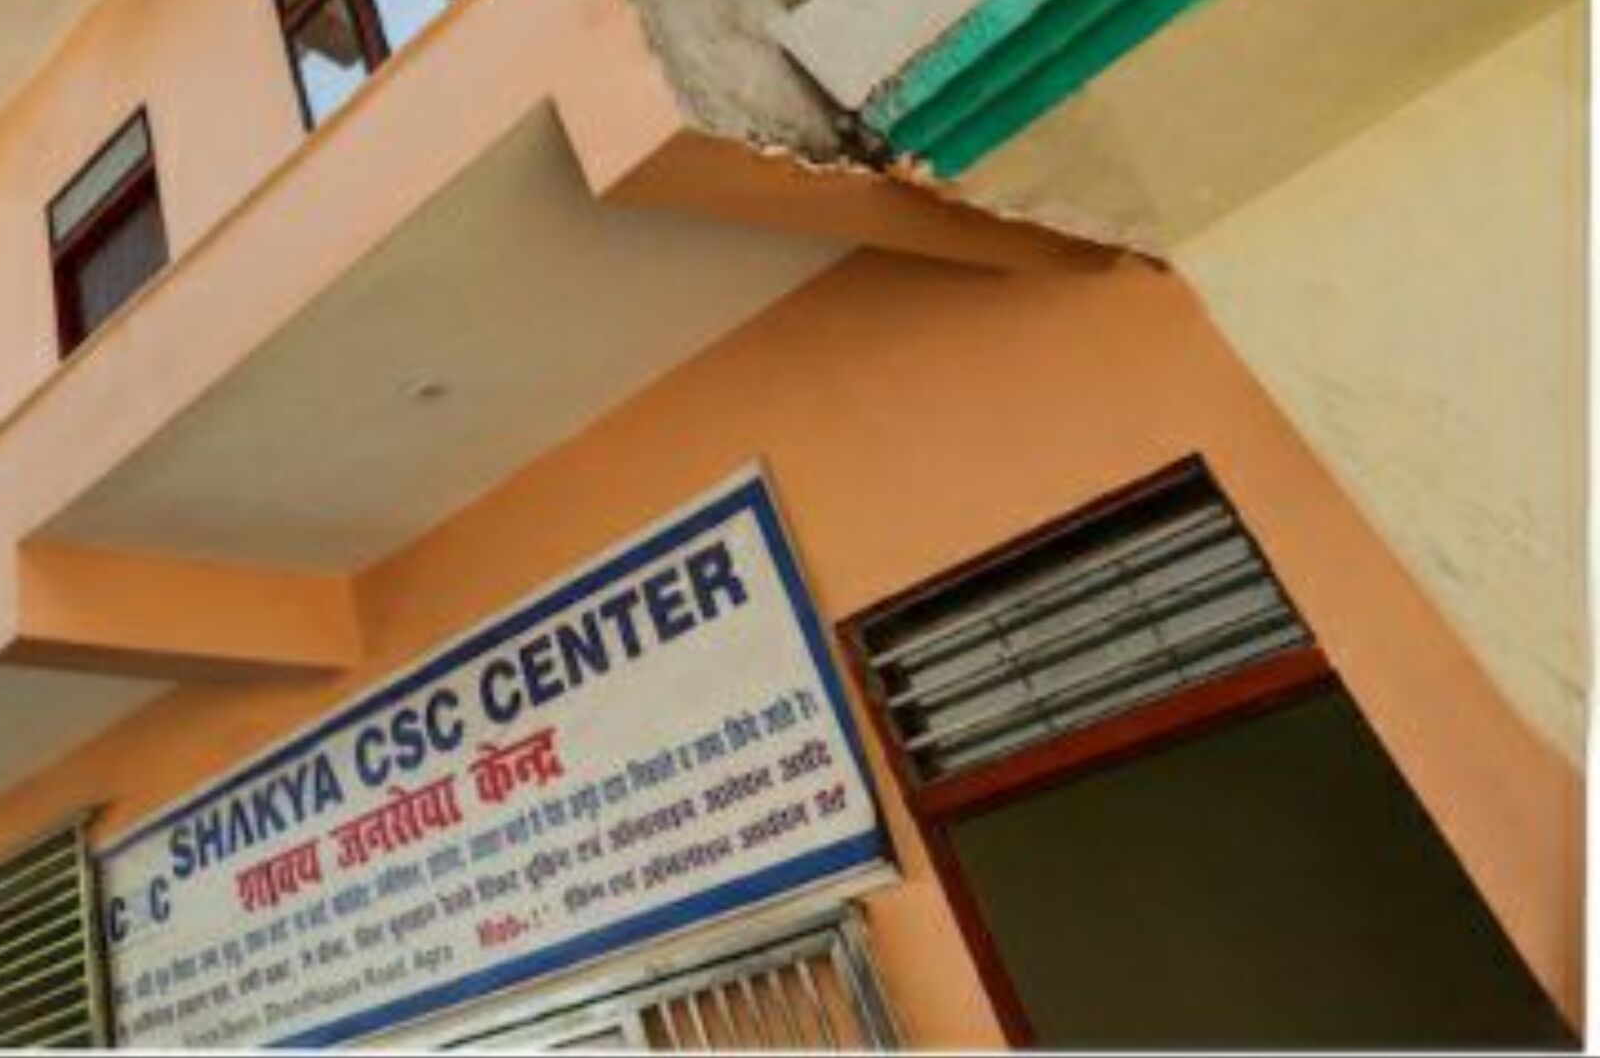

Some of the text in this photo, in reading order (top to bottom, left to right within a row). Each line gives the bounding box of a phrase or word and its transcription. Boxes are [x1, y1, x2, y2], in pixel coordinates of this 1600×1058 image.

[168, 542, 748, 879] SHAKYA CSC CENTER
[330, 773, 462, 869] जनसेवा
